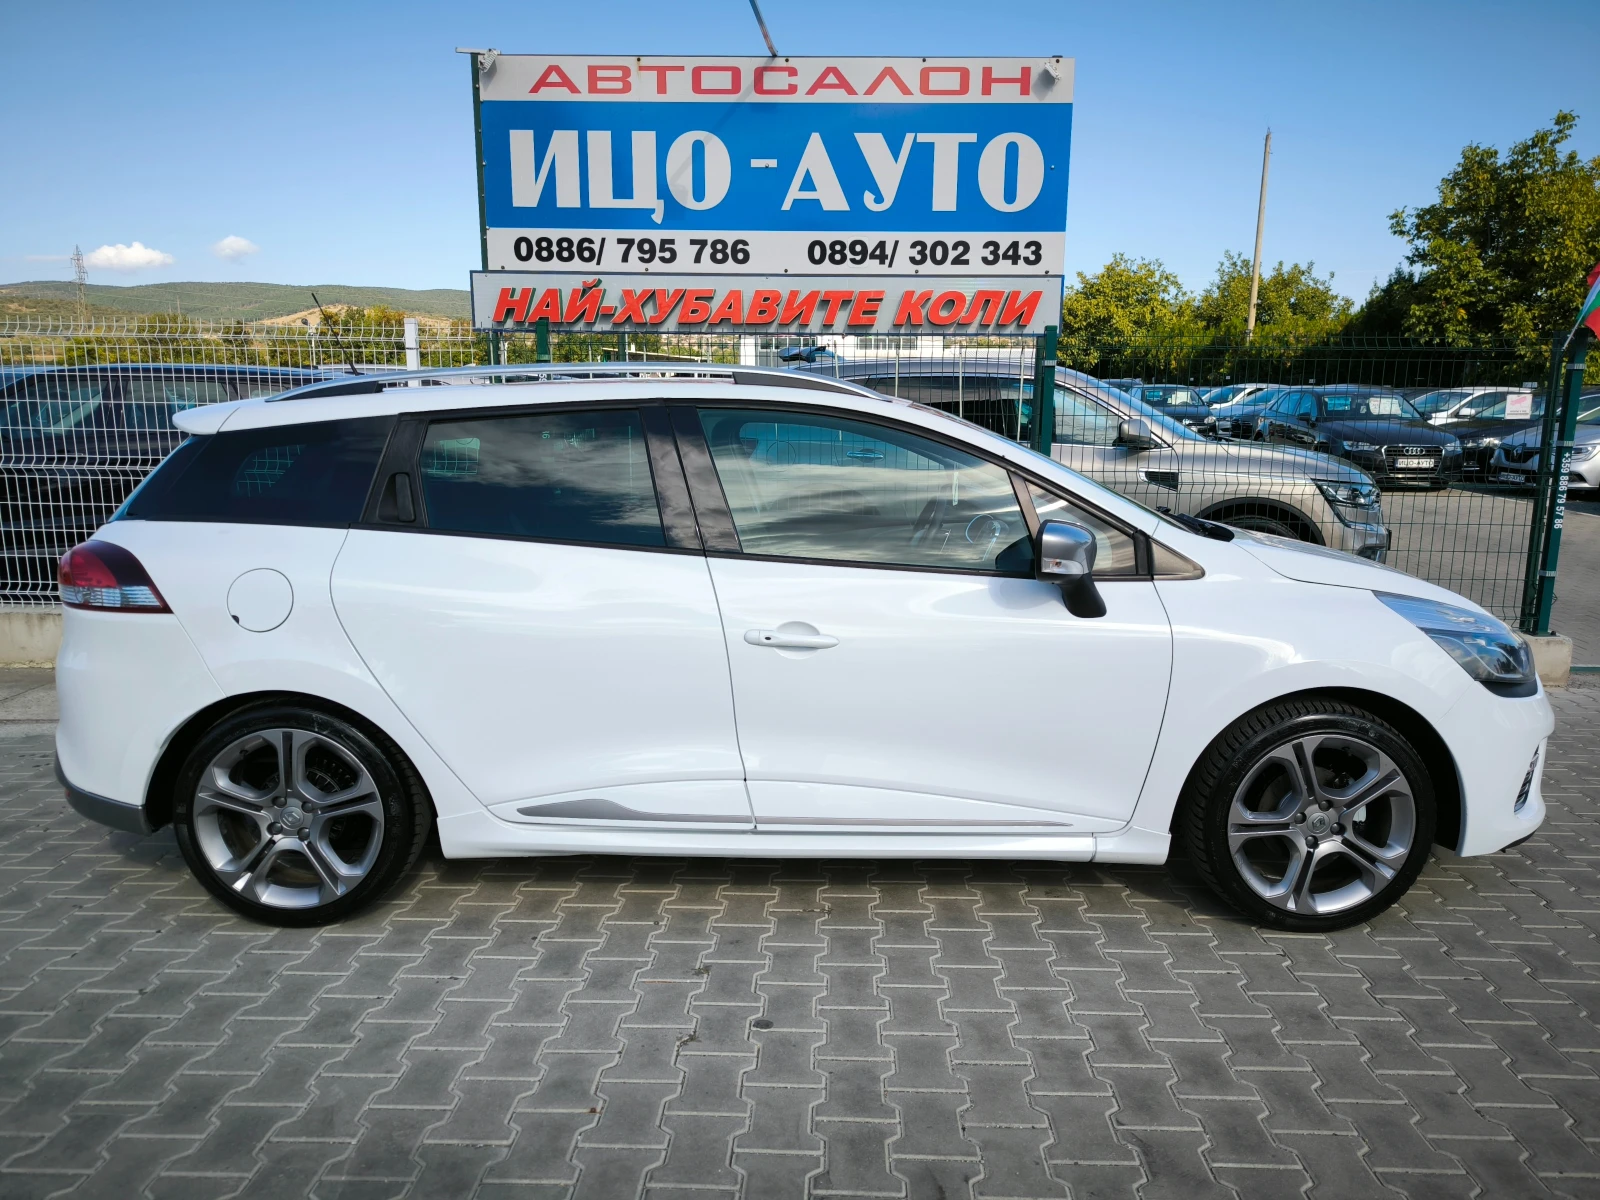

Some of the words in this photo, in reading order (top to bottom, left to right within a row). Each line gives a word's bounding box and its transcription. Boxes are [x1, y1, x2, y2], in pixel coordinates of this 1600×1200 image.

[529, 65, 1031, 97] АВТОСАЛОН
[513, 237, 606, 266] 0886/
[616, 238, 677, 264] 795
[689, 239, 750, 265] 786
[807, 240, 900, 268] 0894/
[908, 241, 971, 266] 302
[981, 241, 1042, 266] 343
[492, 279, 887, 327] НАЙ-ХУБАВИТЕ
[894, 290, 1044, 327] КОЛИ
[1560, 452, 1571, 473] +359
[1558, 475, 1569, 491] 886
[1556, 493, 1567, 504] 79
[1555, 506, 1565, 516] 57
[1553, 518, 1563, 529] 86
